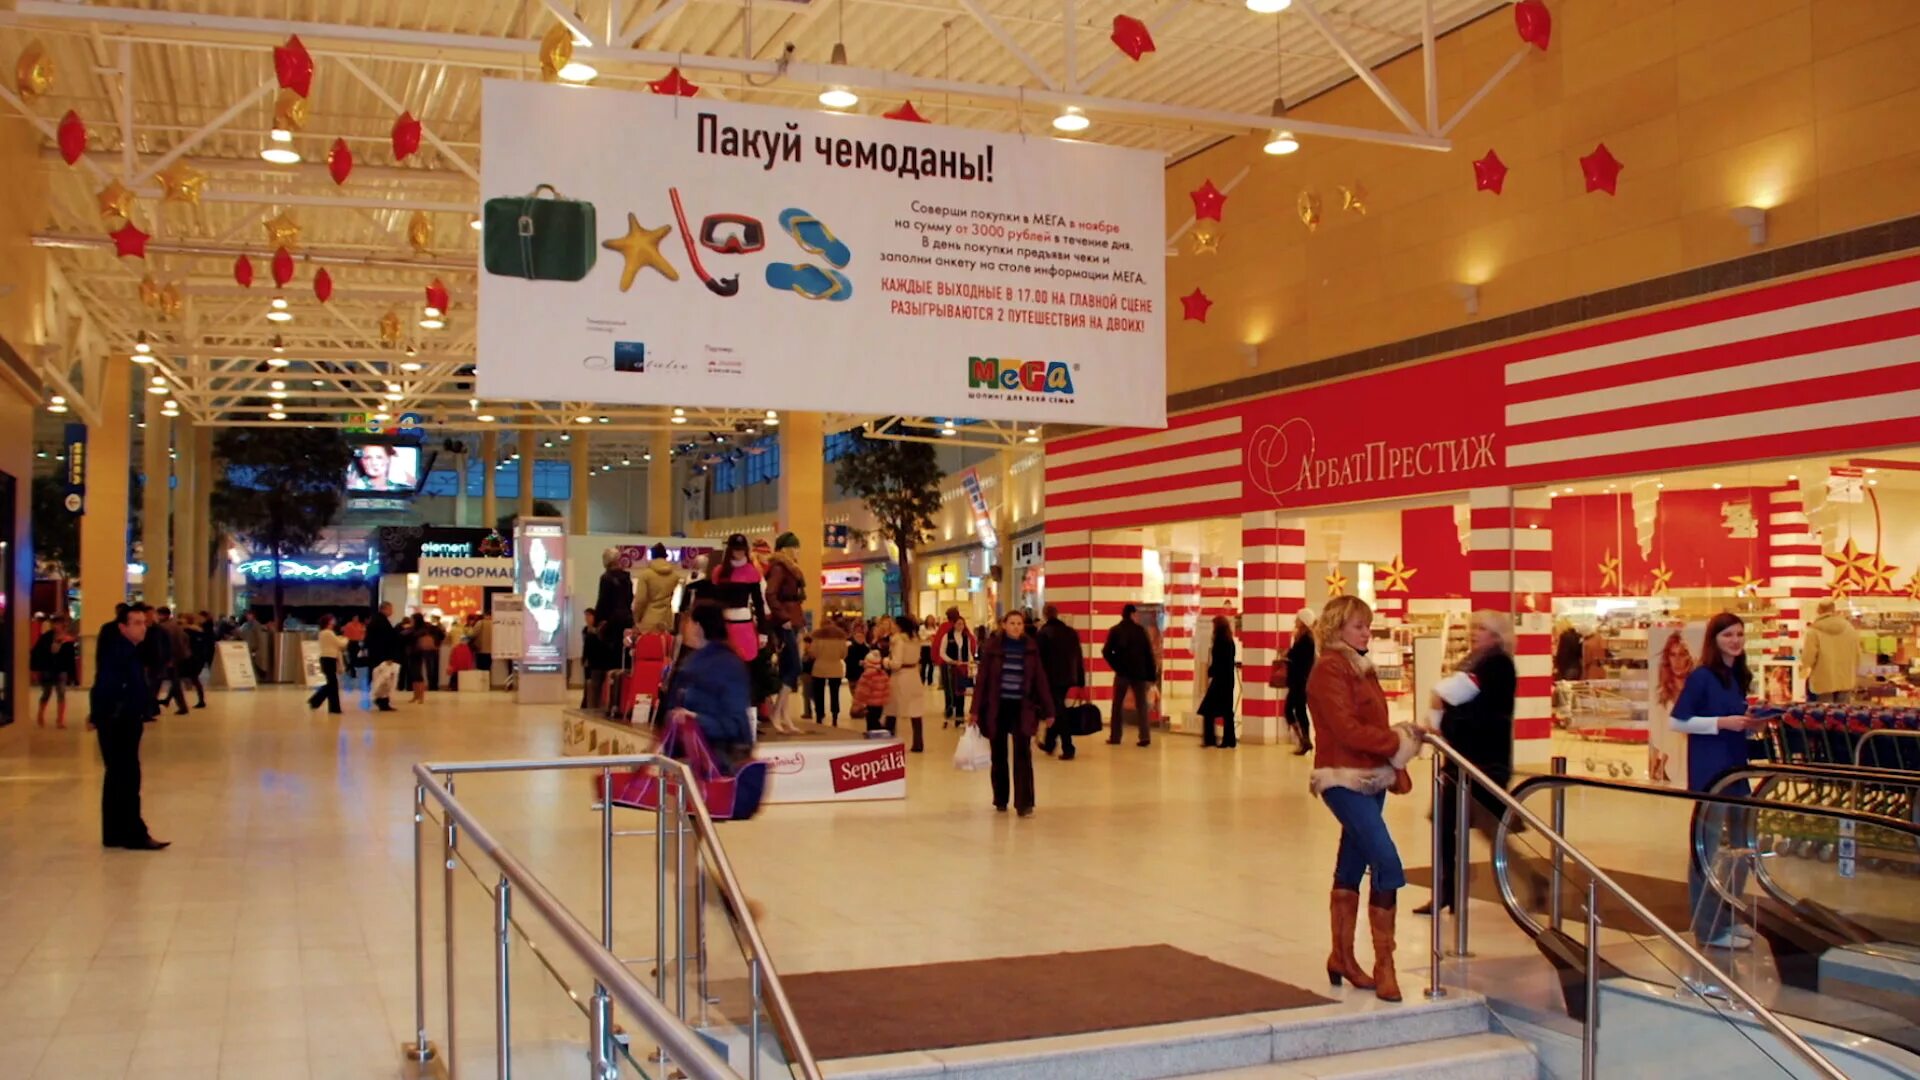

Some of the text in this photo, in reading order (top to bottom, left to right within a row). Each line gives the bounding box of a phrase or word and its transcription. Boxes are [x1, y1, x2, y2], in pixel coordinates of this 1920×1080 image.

[697, 112, 994, 183] Пакуй чемоданы!
[911, 200, 1120, 235] Соверши покупки в МЕГА в ноябре
[895, 220, 1134, 251] на сумму от 3000 рублей в течение дня.
[922, 235, 1110, 264] В день покупки предъяви чеки и
[880, 252, 1147, 285] заполни анкету на столе информации МЕГА.
[881, 277, 1152, 313] КАЖДЫЕ ВЫХОДНЫЕ В 17.00 НА ГЛАВНОЙ СЦЕНЕ
[891, 300, 1144, 333] РАЗЫГРЫВАЮТСЯ 2 ПУТЕШЕСТВИЯ НА ДВОИХ!
[968, 393, 1003, 401] ШОПИНГ
[1026, 395, 1046, 403] ВСЕЙ
[421, 541, 470, 553] element
[841, 751, 905, 781] Seppälä
